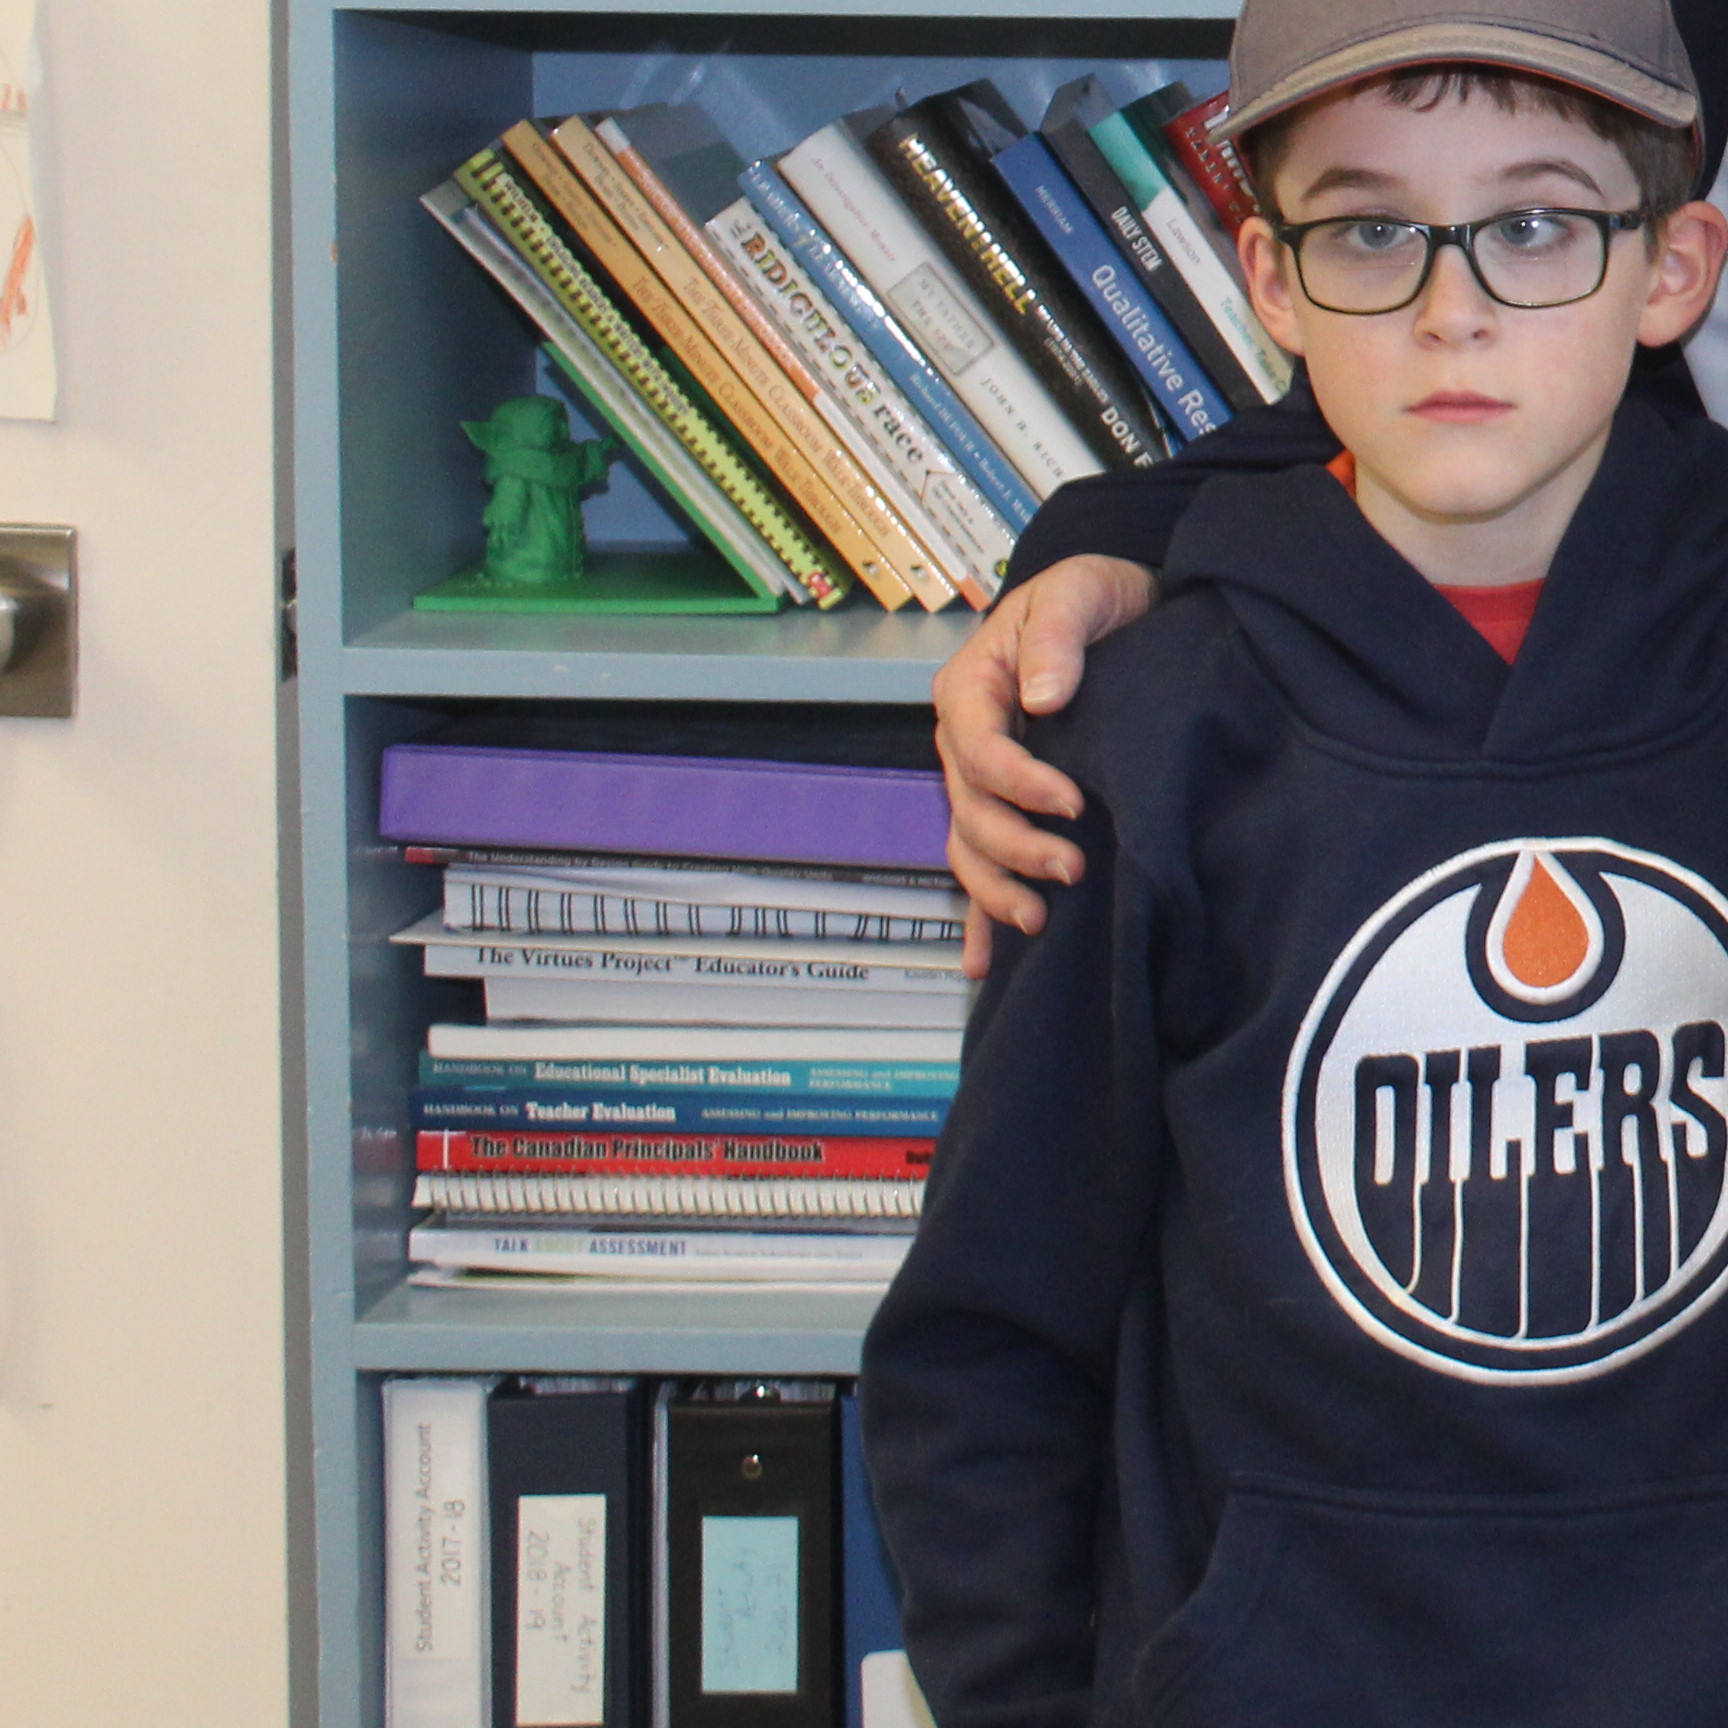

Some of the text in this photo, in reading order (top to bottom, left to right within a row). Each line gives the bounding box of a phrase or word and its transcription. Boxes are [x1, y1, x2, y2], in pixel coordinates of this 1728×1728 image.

[895, 131, 1043, 316] HEAVEN HELL
[1108, 204, 1165, 274] DAILY STEM
[734, 230, 928, 465] RIDICULOUS race
[1084, 261, 1194, 393] Qualitative
[979, 375, 1017, 416] JOHN
[1099, 405, 1142, 454] DON
[477, 946, 514, 967] The
[521, 947, 594, 969] Virtues
[806, 962, 870, 981] Guide
[533, 1062, 627, 1082] Educational
[628, 1064, 705, 1086] Specialist
[708, 1067, 793, 1088] Evaluation
[525, 1101, 589, 1121] Teacher
[592, 1102, 677, 1122] Evaluation
[470, 1135, 508, 1158] The
[511, 1137, 607, 1160] Canadian
[723, 1140, 824, 1163] Handbook
[1353, 1020, 1728, 1257] OILERS
[494, 1238, 529, 1254] TALK
[588, 1239, 687, 1256] ASSESSMENT
[415, 1422, 434, 1653] Student Activity Account
